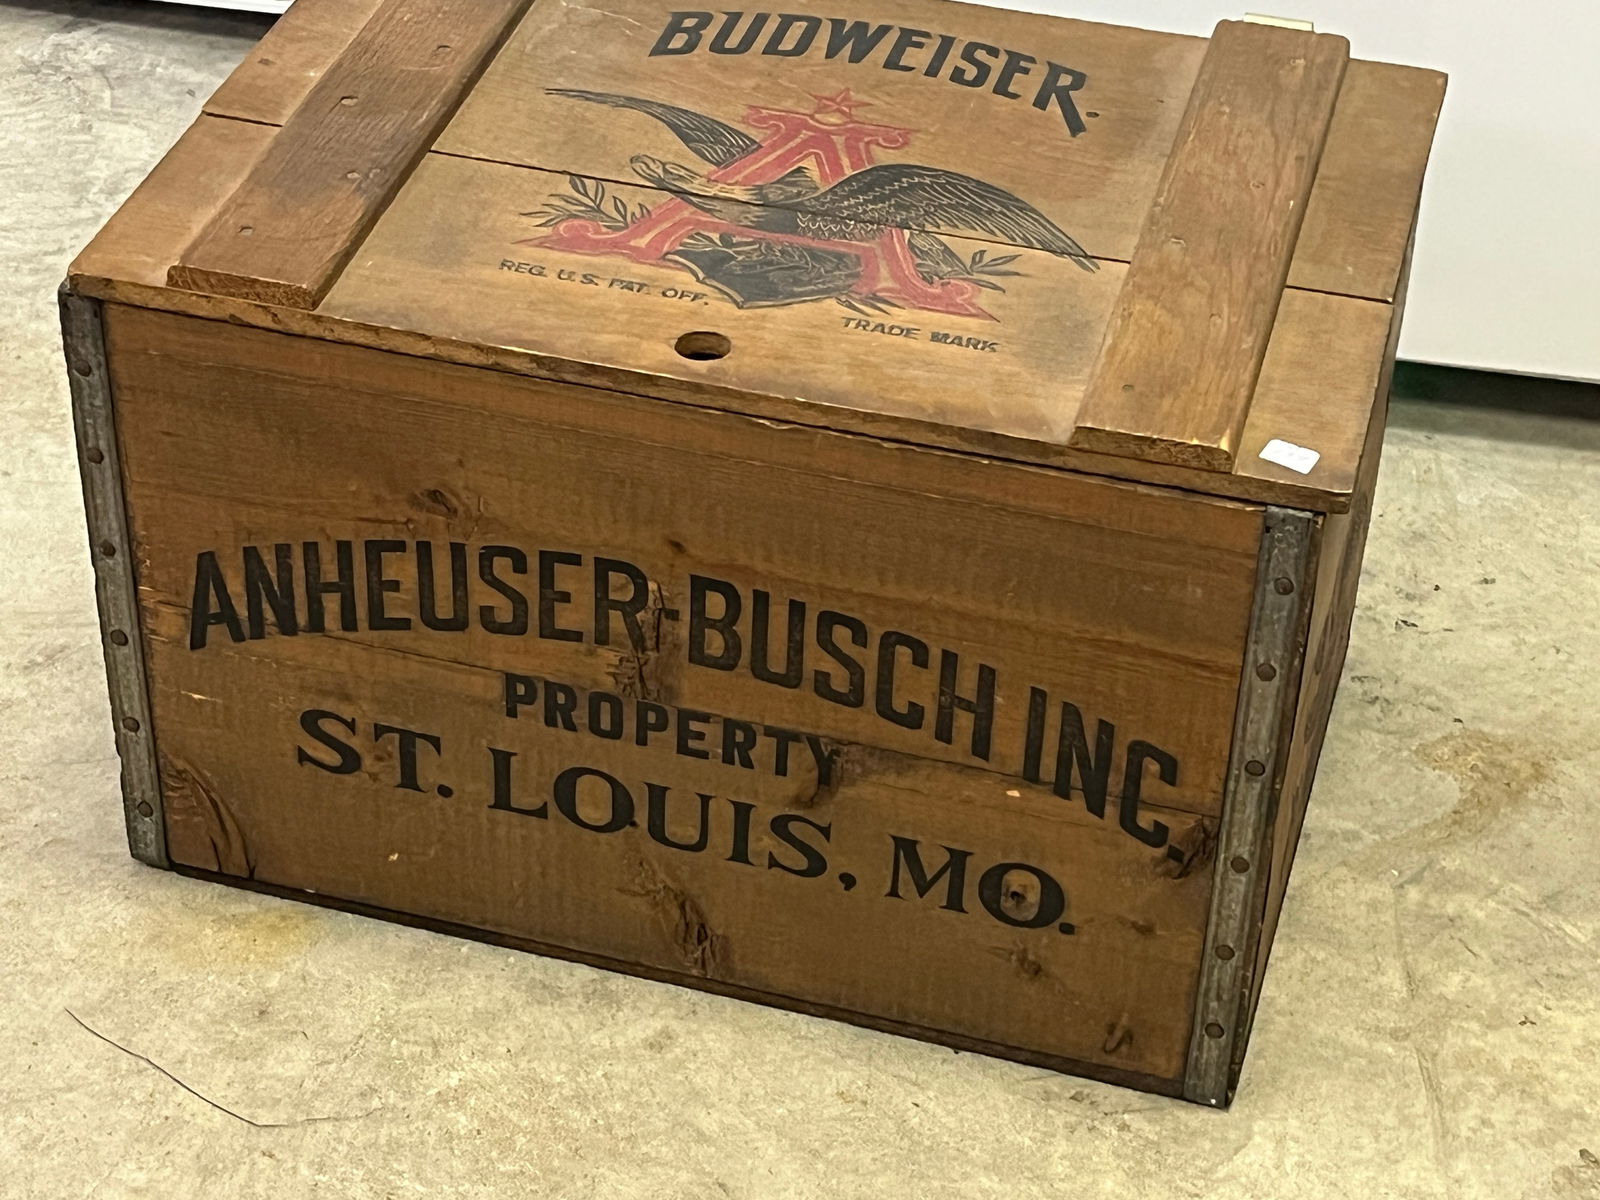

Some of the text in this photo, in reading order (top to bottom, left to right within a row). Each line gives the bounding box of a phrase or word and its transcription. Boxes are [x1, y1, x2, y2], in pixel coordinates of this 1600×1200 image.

[661, 287, 709, 306] OFF.
[841, 316, 1001, 353] TRADE MARK
[189, 539, 1185, 863] ANHEUSER-BUSCH INC.
[505, 672, 842, 788] PROPERTY
[297, 708, 1076, 936] ST. LOUIS, MO.
